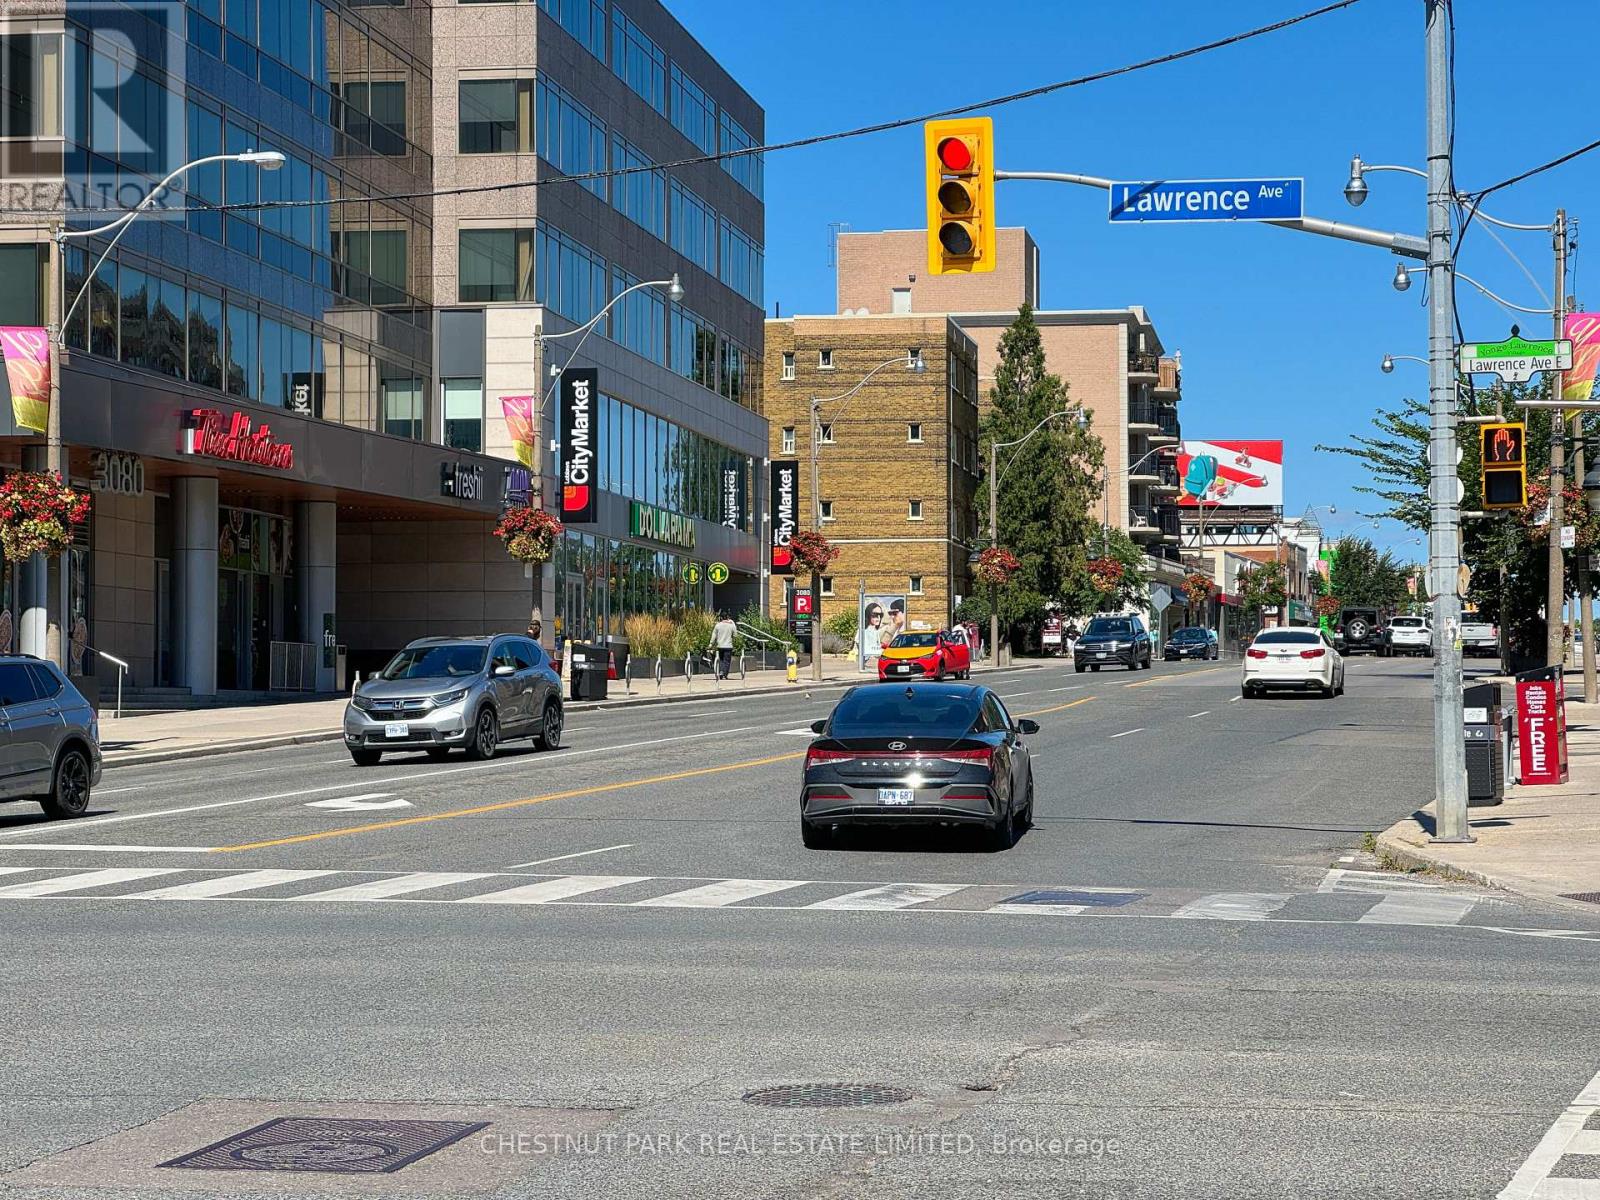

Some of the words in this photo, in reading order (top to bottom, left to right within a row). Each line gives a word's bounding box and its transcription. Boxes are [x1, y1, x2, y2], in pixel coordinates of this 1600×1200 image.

[1123, 187, 1250, 212] Lawrence
[1258, 184, 1283, 198] Ave
[1469, 359, 1526, 372] Lawrence
[1530, 356, 1552, 370] Ave
[1556, 356, 1562, 369] E
[1480, 344, 1507, 356] Yonge
[1509, 342, 1554, 356] Lawrence
[570, 379, 593, 485] CityMarket
[92, 452, 145, 497] 3080
[455, 461, 484, 501] freshii
[778, 468, 796, 547] CityMarket
[797, 597, 807, 611] P
[1530, 717, 1546, 771] FREE
